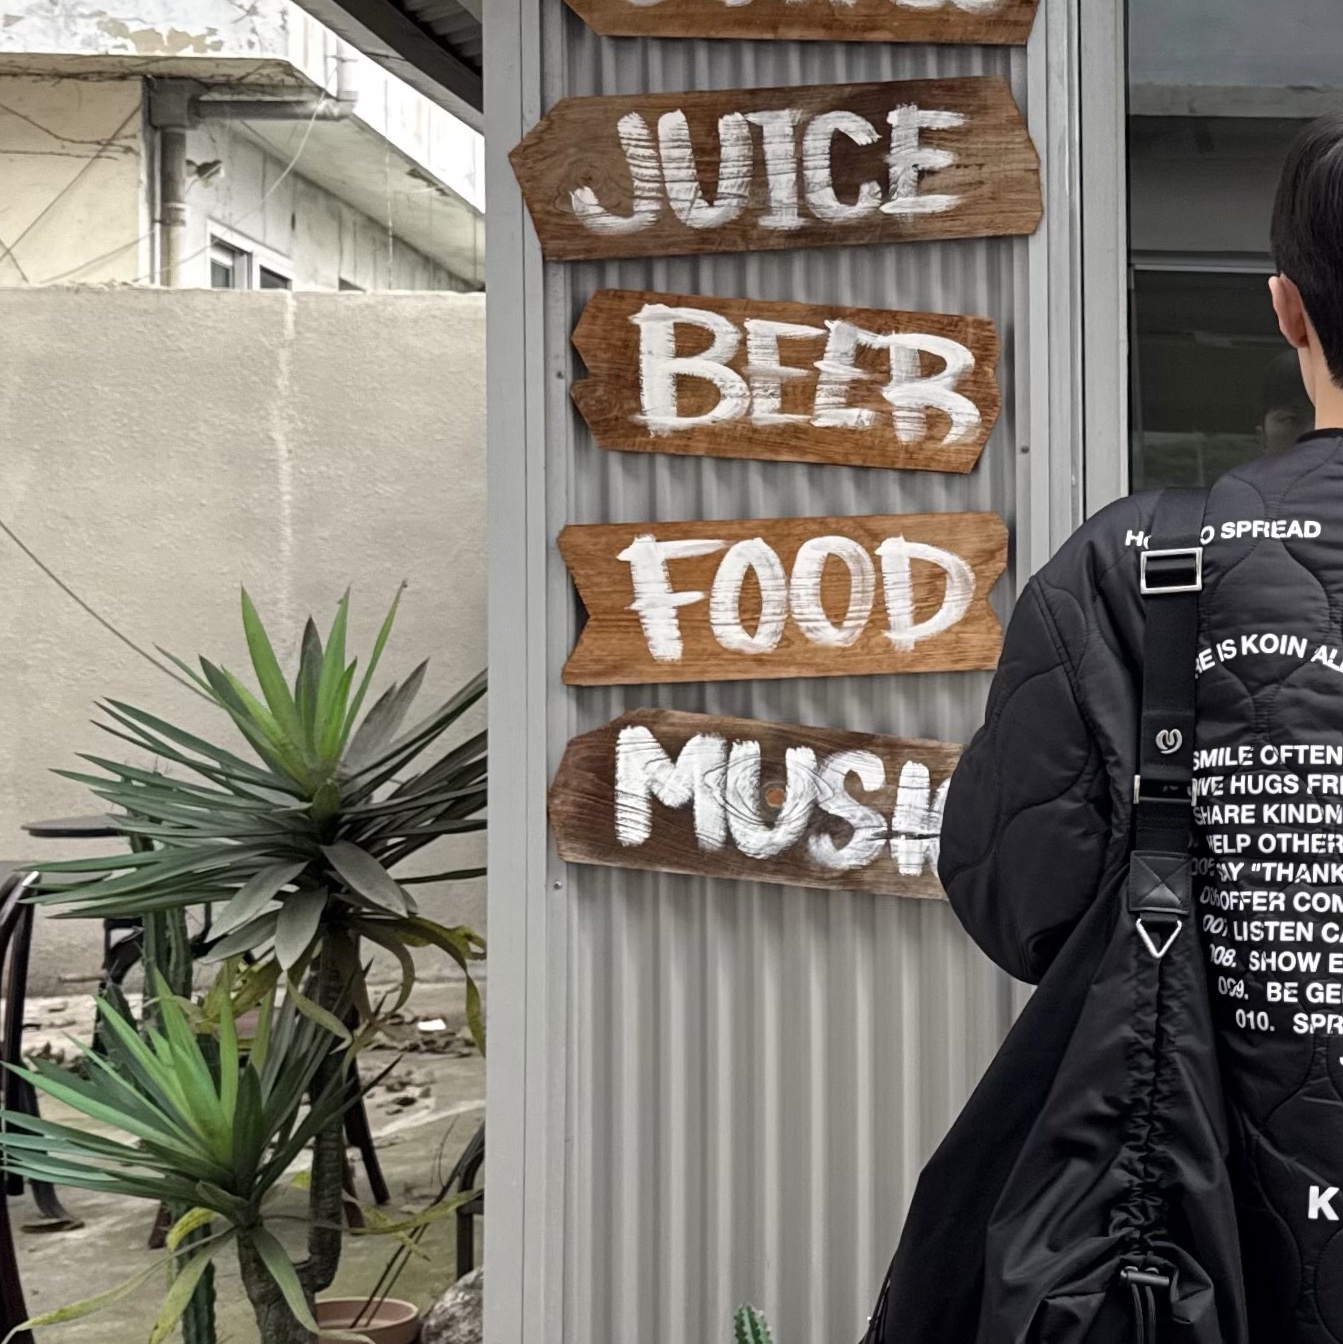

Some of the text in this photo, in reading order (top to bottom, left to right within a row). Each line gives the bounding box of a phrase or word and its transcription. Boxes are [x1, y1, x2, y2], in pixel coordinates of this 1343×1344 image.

[569, 103, 972, 234] JUICE
[628, 303, 982, 450] BEER
[1200, 525, 1215, 545] O
[1220, 519, 1322, 539] SPREAD
[616, 533, 976, 661] FOOD
[1216, 638, 1238, 662] IS
[1240, 633, 1308, 659] KOIN
[1193, 744, 1343, 771] SMILE OFTEN
[1230, 773, 1300, 795] HUGS
[1193, 803, 1257, 826] SHARE
[1219, 890, 1286, 912] OFFER
[1233, 920, 1315, 942] LISTEN
[1248, 950, 1322, 973] SHOW
[1265, 981, 1299, 1003] BE
[1235, 1008, 1275, 1032] 010.
